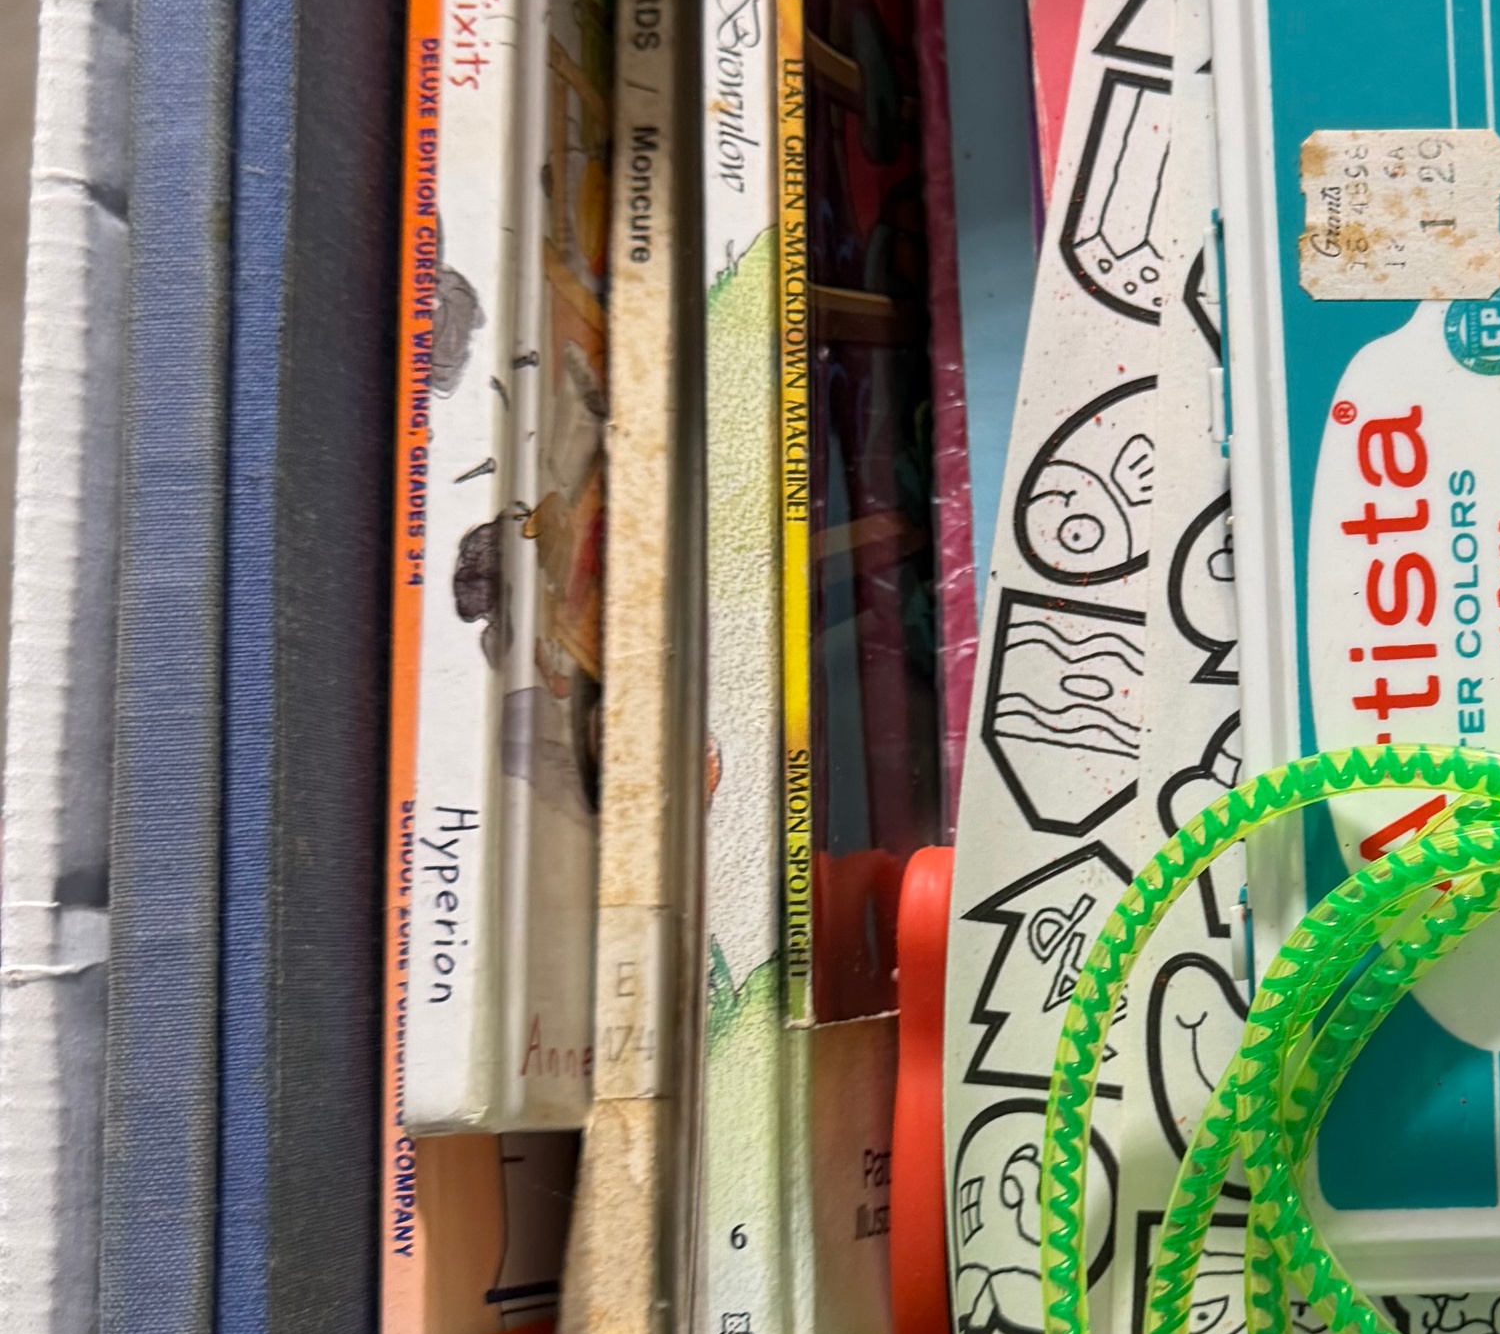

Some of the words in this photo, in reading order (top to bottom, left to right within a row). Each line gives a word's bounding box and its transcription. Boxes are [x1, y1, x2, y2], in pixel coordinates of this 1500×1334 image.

[416, 36, 440, 119] DELUXE
[414, 126, 438, 218] EDITION
[625, 125, 661, 266] Moncure
[783, 135, 802, 212] GREEN
[1309, 184, 1342, 259] Grants
[411, 224, 438, 321] CURSIVE
[783, 219, 808, 395] SMACKDOWN
[407, 330, 434, 436] WRITING,
[406, 445, 429, 539] GRADES
[783, 400, 809, 524] MACHINE!
[404, 546, 425, 587] 3-4
[1448, 468, 1482, 660] COLORS
[787, 748, 810, 834] SIMON
[421, 805, 480, 1006] Hyperion
[789, 836, 812, 979] SPOTLIGHT
[391, 1135, 417, 1259] COMPANY
[729, 1222, 748, 1251] 6
